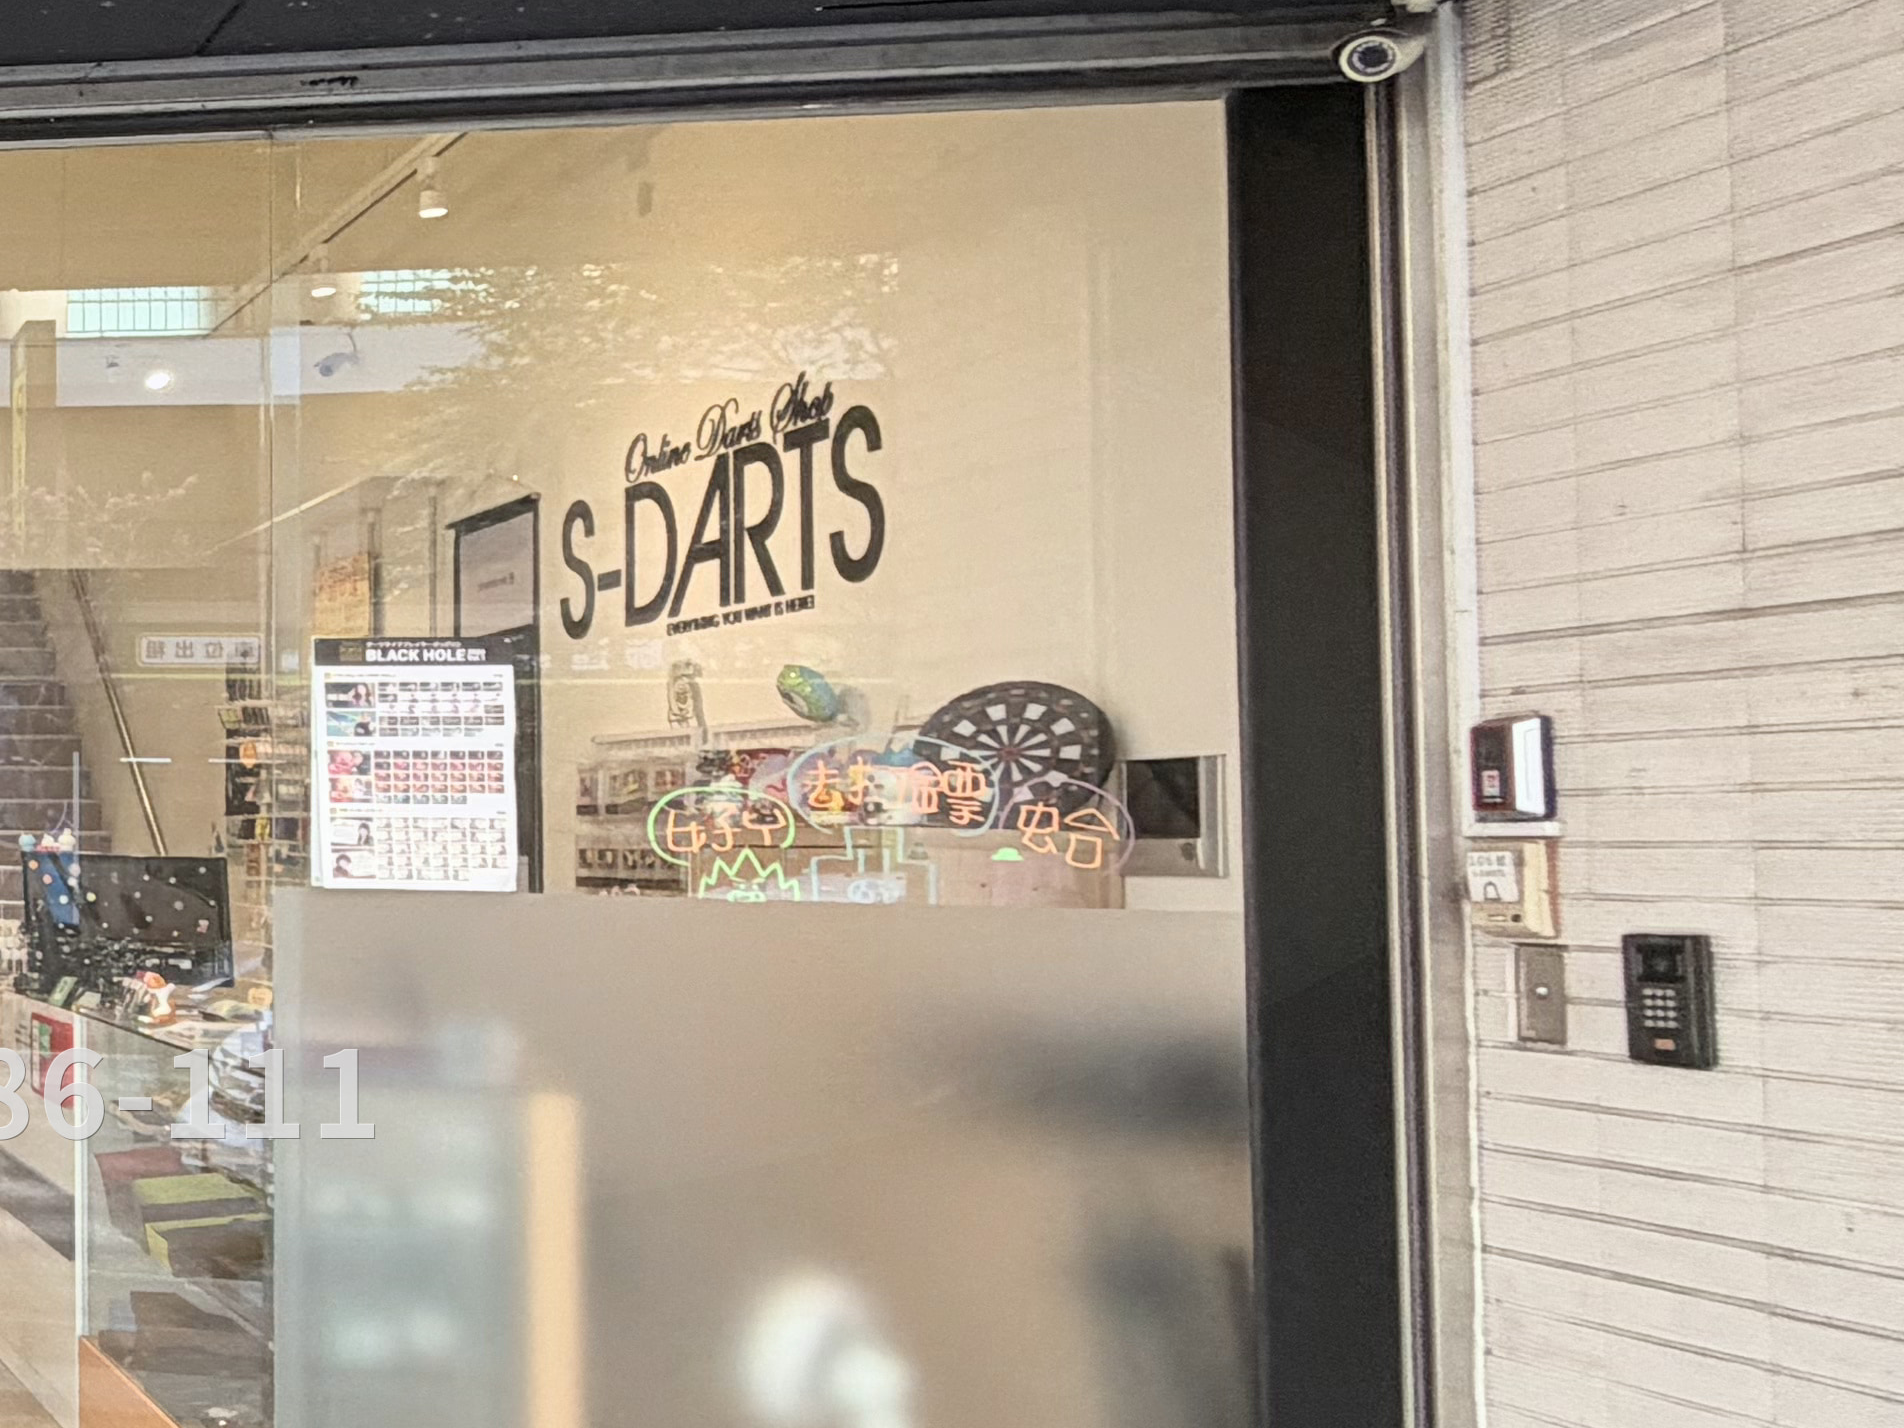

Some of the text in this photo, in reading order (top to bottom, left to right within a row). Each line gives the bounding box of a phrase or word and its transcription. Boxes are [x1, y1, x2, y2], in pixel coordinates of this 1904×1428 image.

[625, 433, 691, 483] Online
[694, 398, 763, 461] Darts
[560, 405, 886, 640] S-DARTS
[365, 648, 420, 662] BLACK
[423, 648, 466, 661] HOLE
